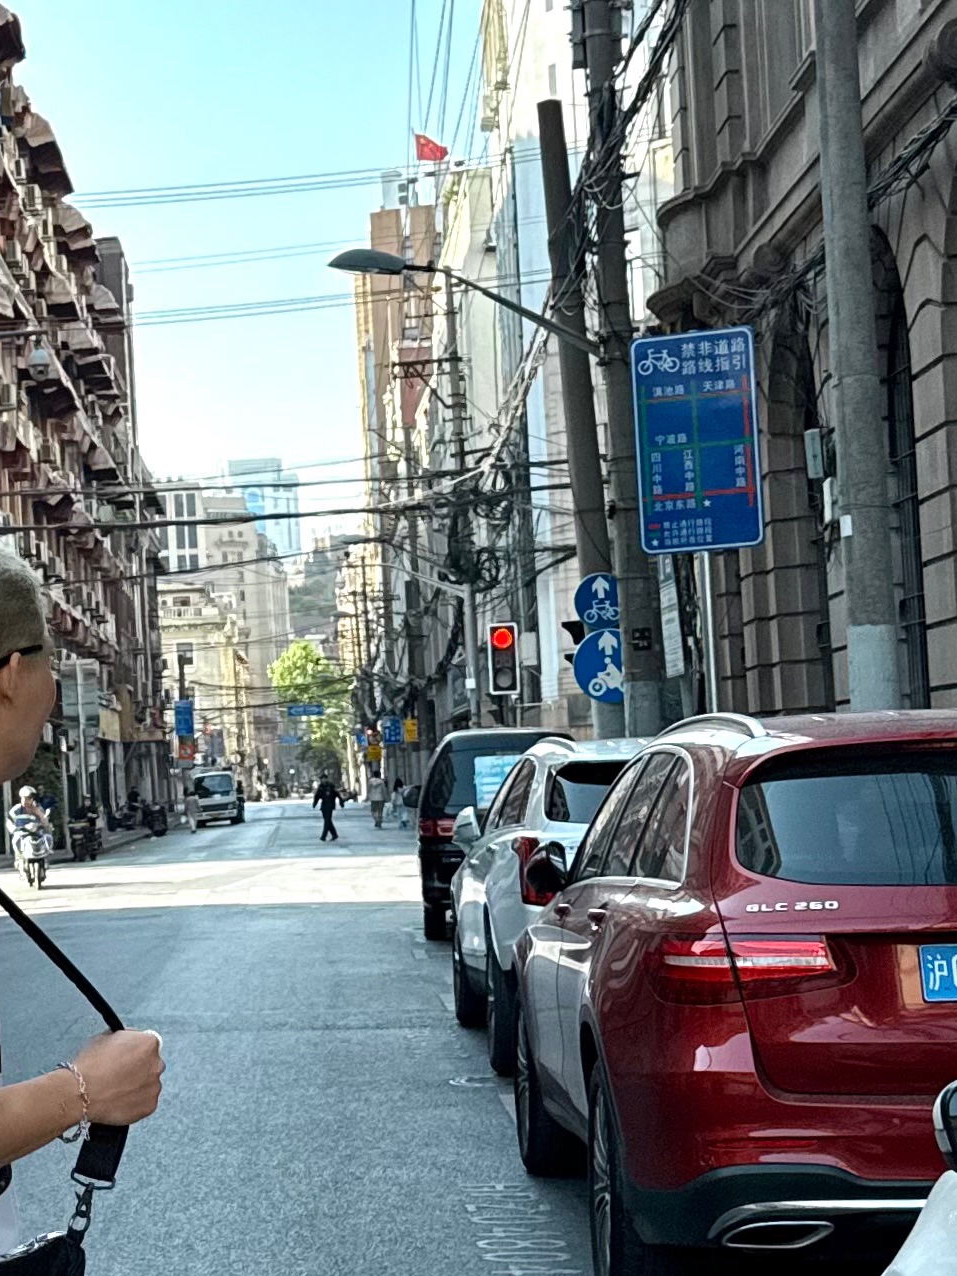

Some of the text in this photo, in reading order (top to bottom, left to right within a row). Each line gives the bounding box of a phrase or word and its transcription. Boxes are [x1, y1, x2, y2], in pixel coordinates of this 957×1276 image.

[681, 337, 745, 359] 禁非道路
[681, 353, 746, 375] 路线指引
[703, 379, 735, 392] 天津路
[651, 452, 663, 495] 四川中路
[683, 449, 695, 492] 江西中路
[653, 499, 696, 511] 北京东路
[745, 900, 839, 912] GLC 260
[926, 953, 957, 991] 沪
